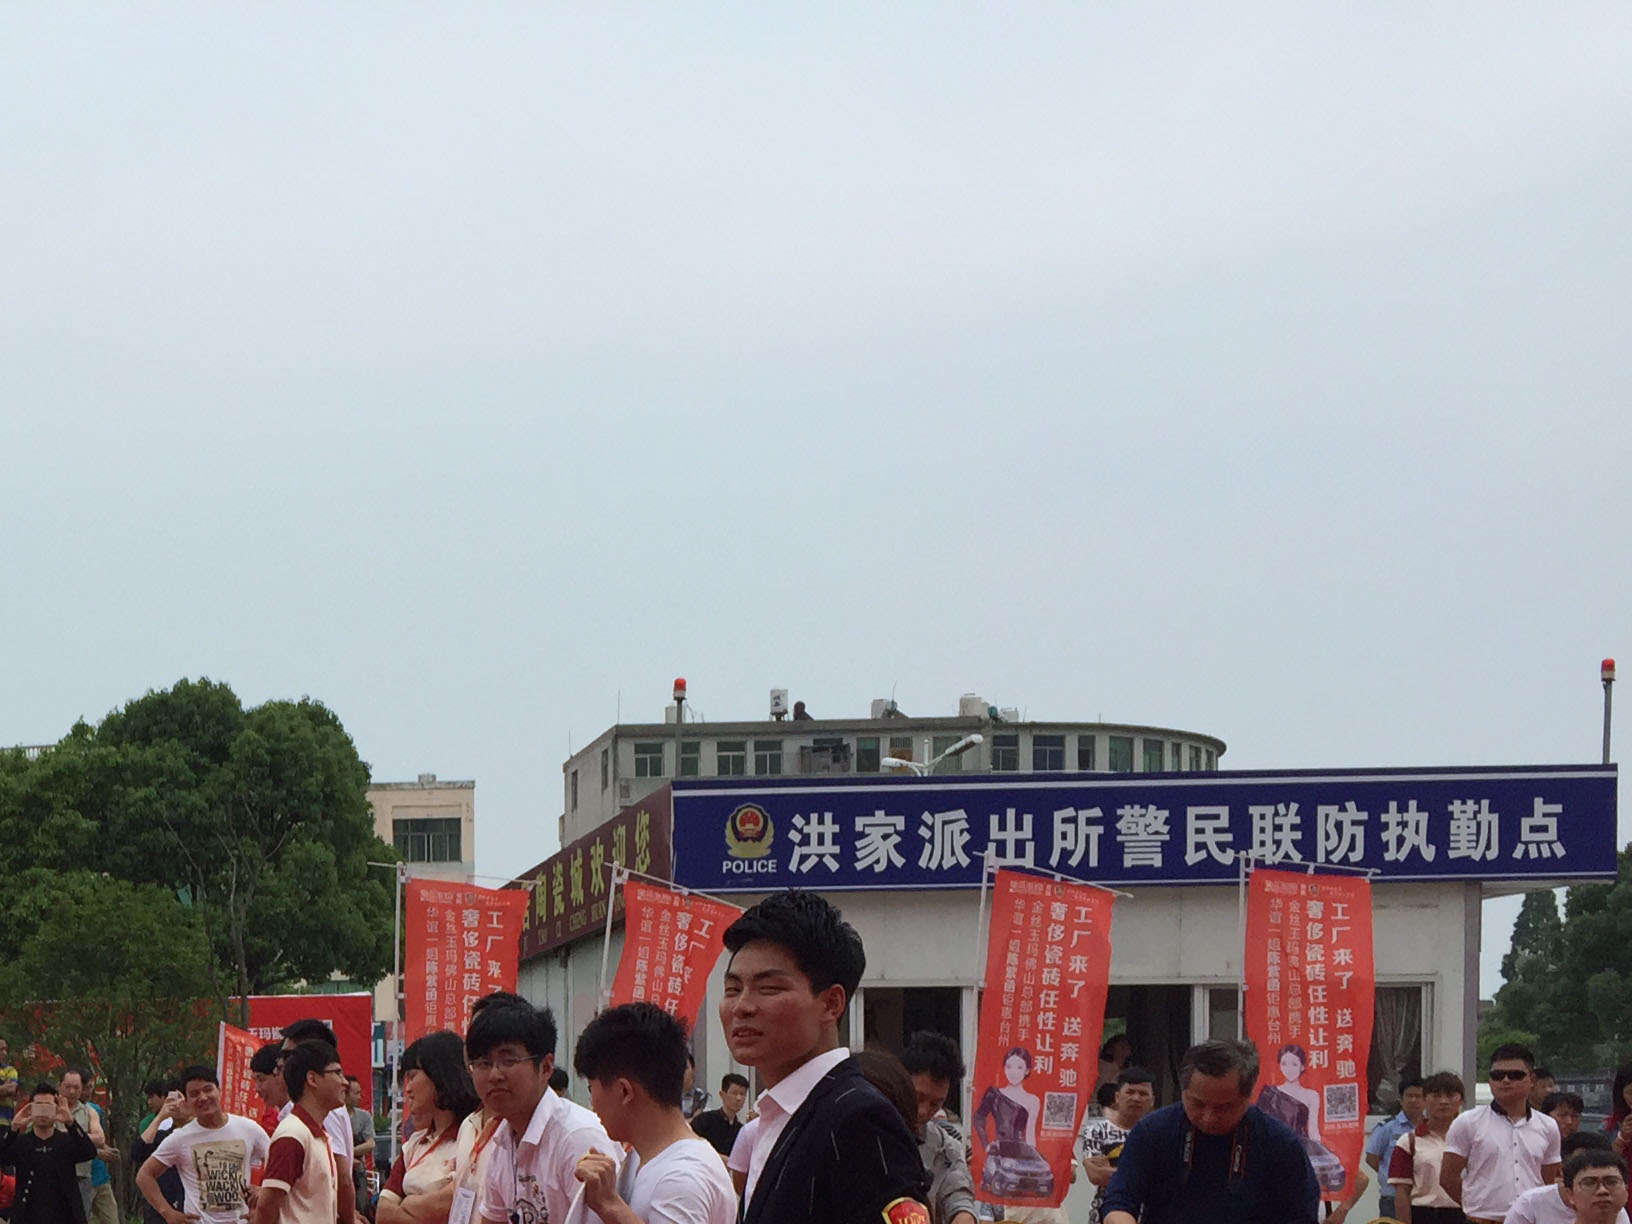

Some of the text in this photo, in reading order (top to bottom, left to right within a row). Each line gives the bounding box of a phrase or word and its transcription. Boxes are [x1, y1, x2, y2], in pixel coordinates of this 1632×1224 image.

[722, 859, 778, 874] POLICE
[786, 797, 1567, 874] 洪家派出所警民联防执勤点
[1068, 905, 1093, 999] 工厂来了
[1305, 901, 1329, 1069] 奢侈瓷砖任性让利
[1331, 902, 1354, 989] 工厂来了
[1033, 902, 1068, 1075] 奢侈瓷砖任性让利
[1058, 1016, 1082, 1088] 送奔驰
[1335, 1008, 1357, 1079] 送奔驰
